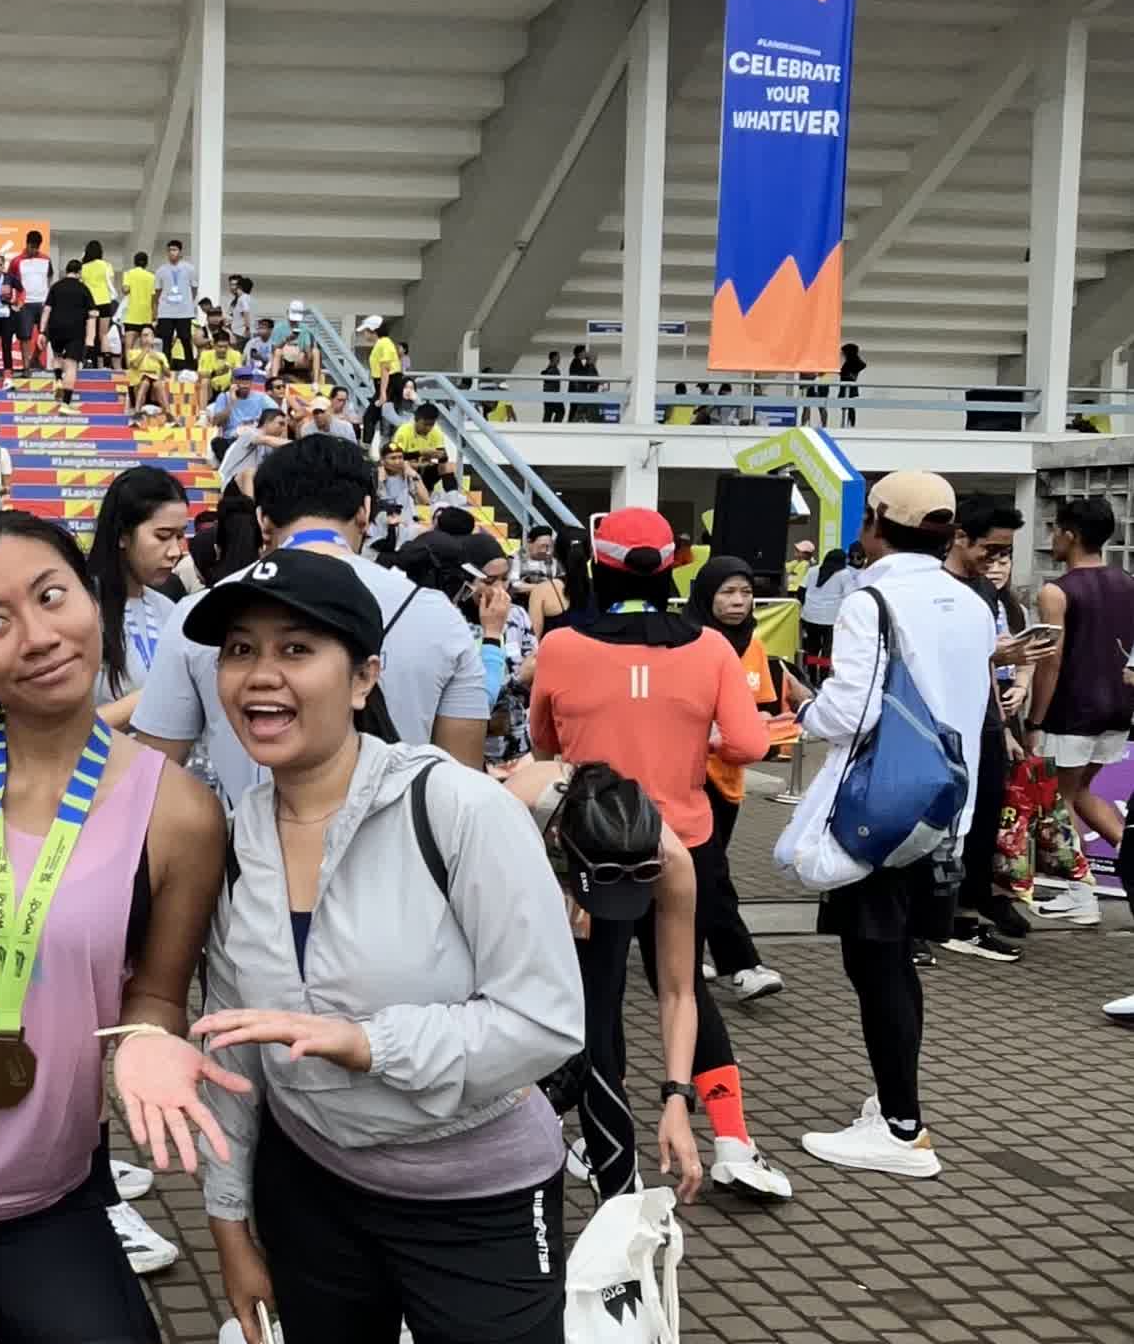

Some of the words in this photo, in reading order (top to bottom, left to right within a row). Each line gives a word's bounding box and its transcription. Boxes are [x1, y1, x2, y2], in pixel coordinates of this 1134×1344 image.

[729, 51, 841, 83] CELEBRATE
[766, 85, 810, 104] YOUR
[732, 109, 840, 136] WHATEVER
